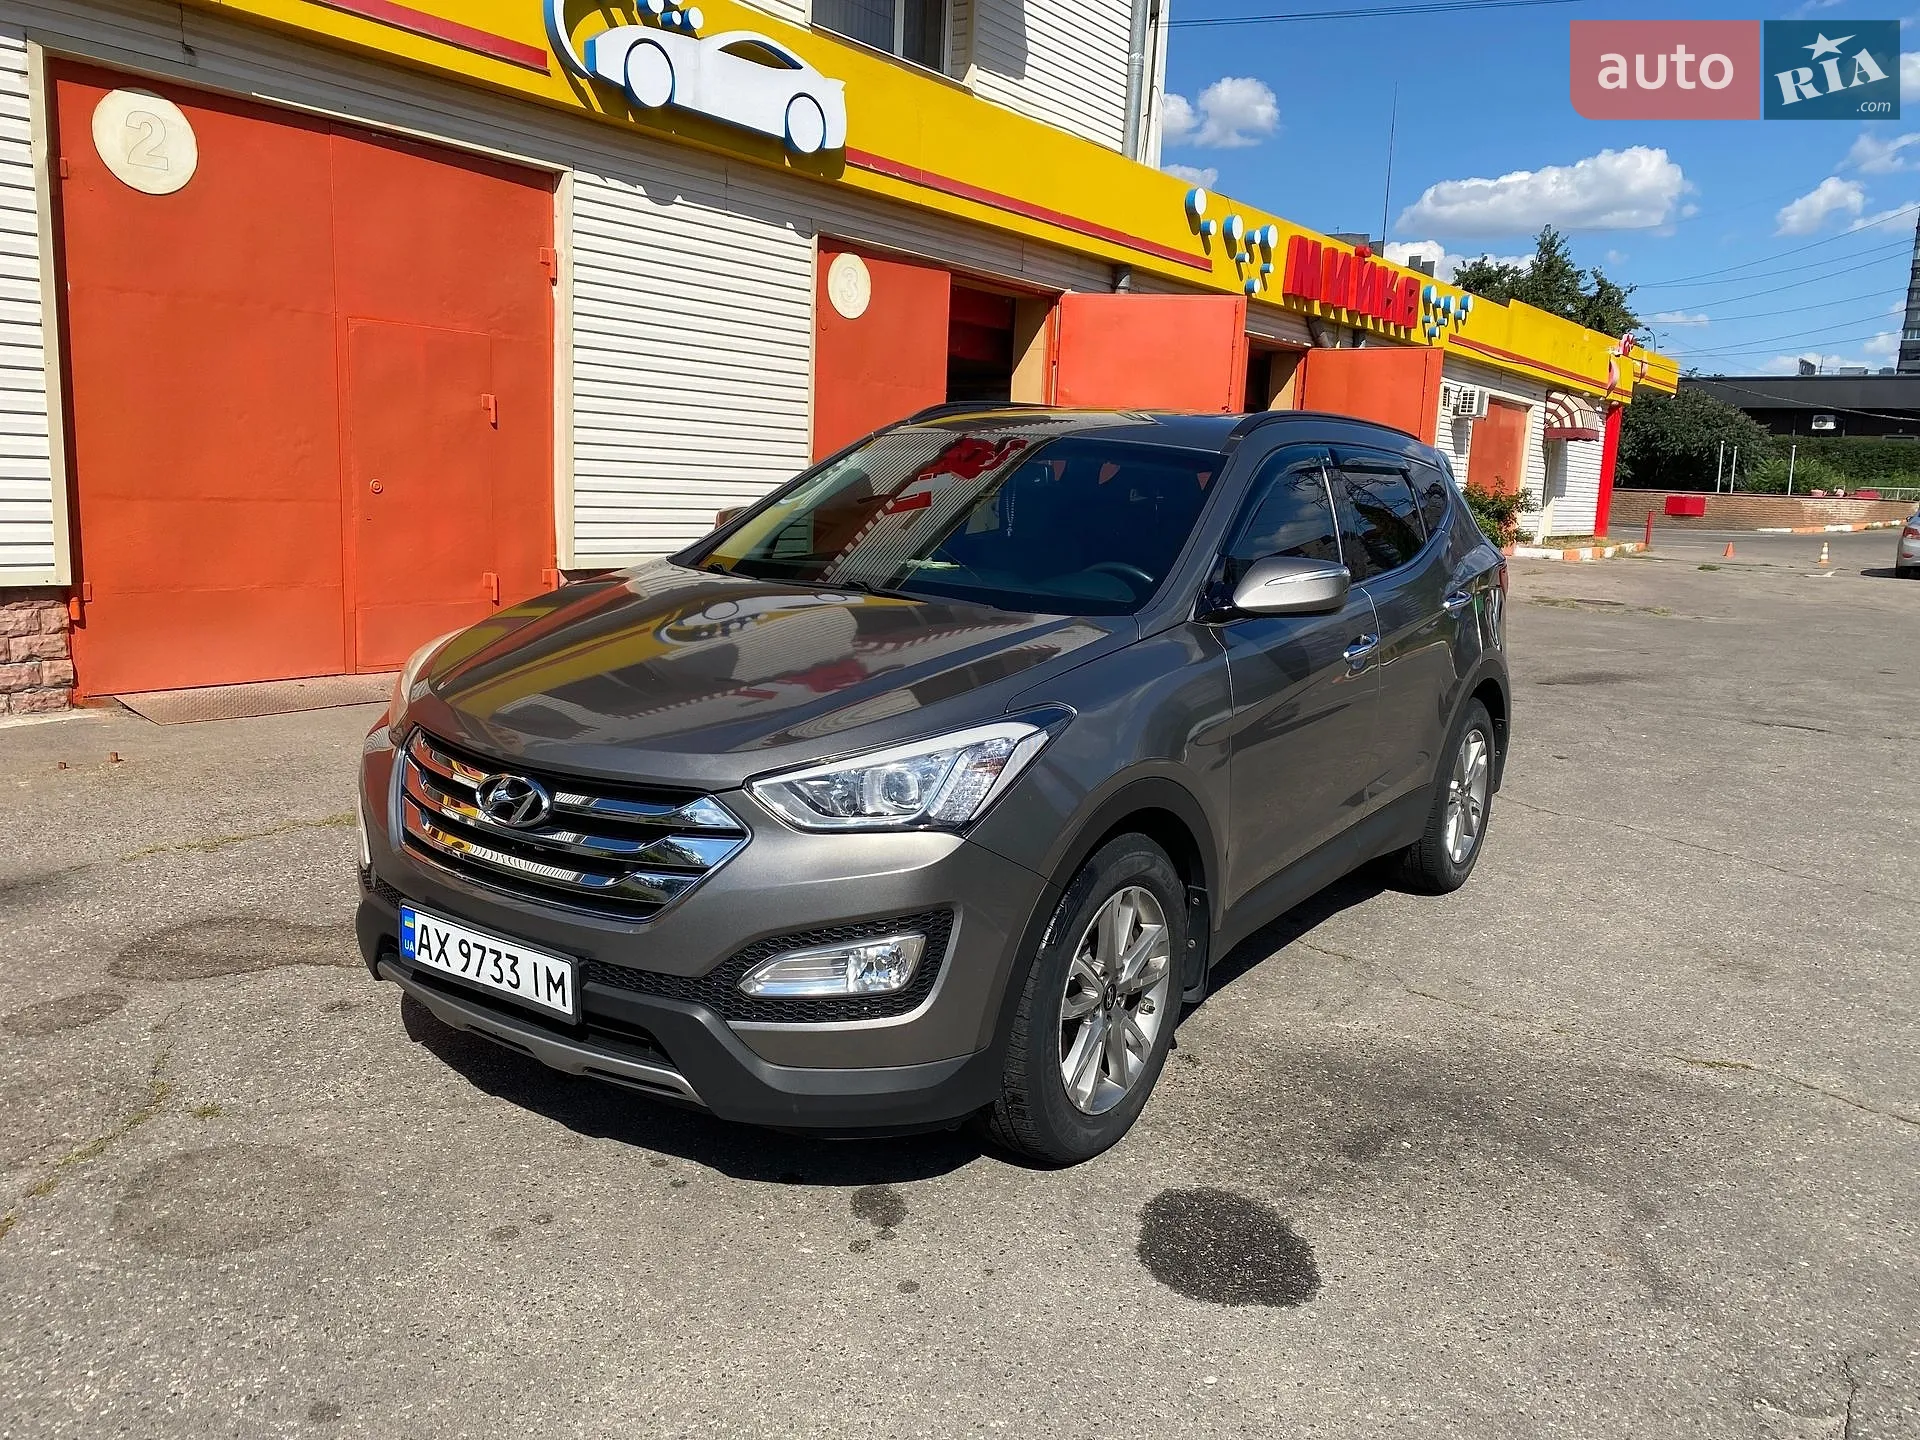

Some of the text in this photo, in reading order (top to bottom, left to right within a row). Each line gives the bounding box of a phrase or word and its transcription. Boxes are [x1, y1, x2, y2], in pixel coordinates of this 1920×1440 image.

[125, 110, 169, 171] 2
[840, 266, 859, 304] 3
[404, 939, 415, 953] UA
[417, 923, 567, 1008] AX 9733 IM
